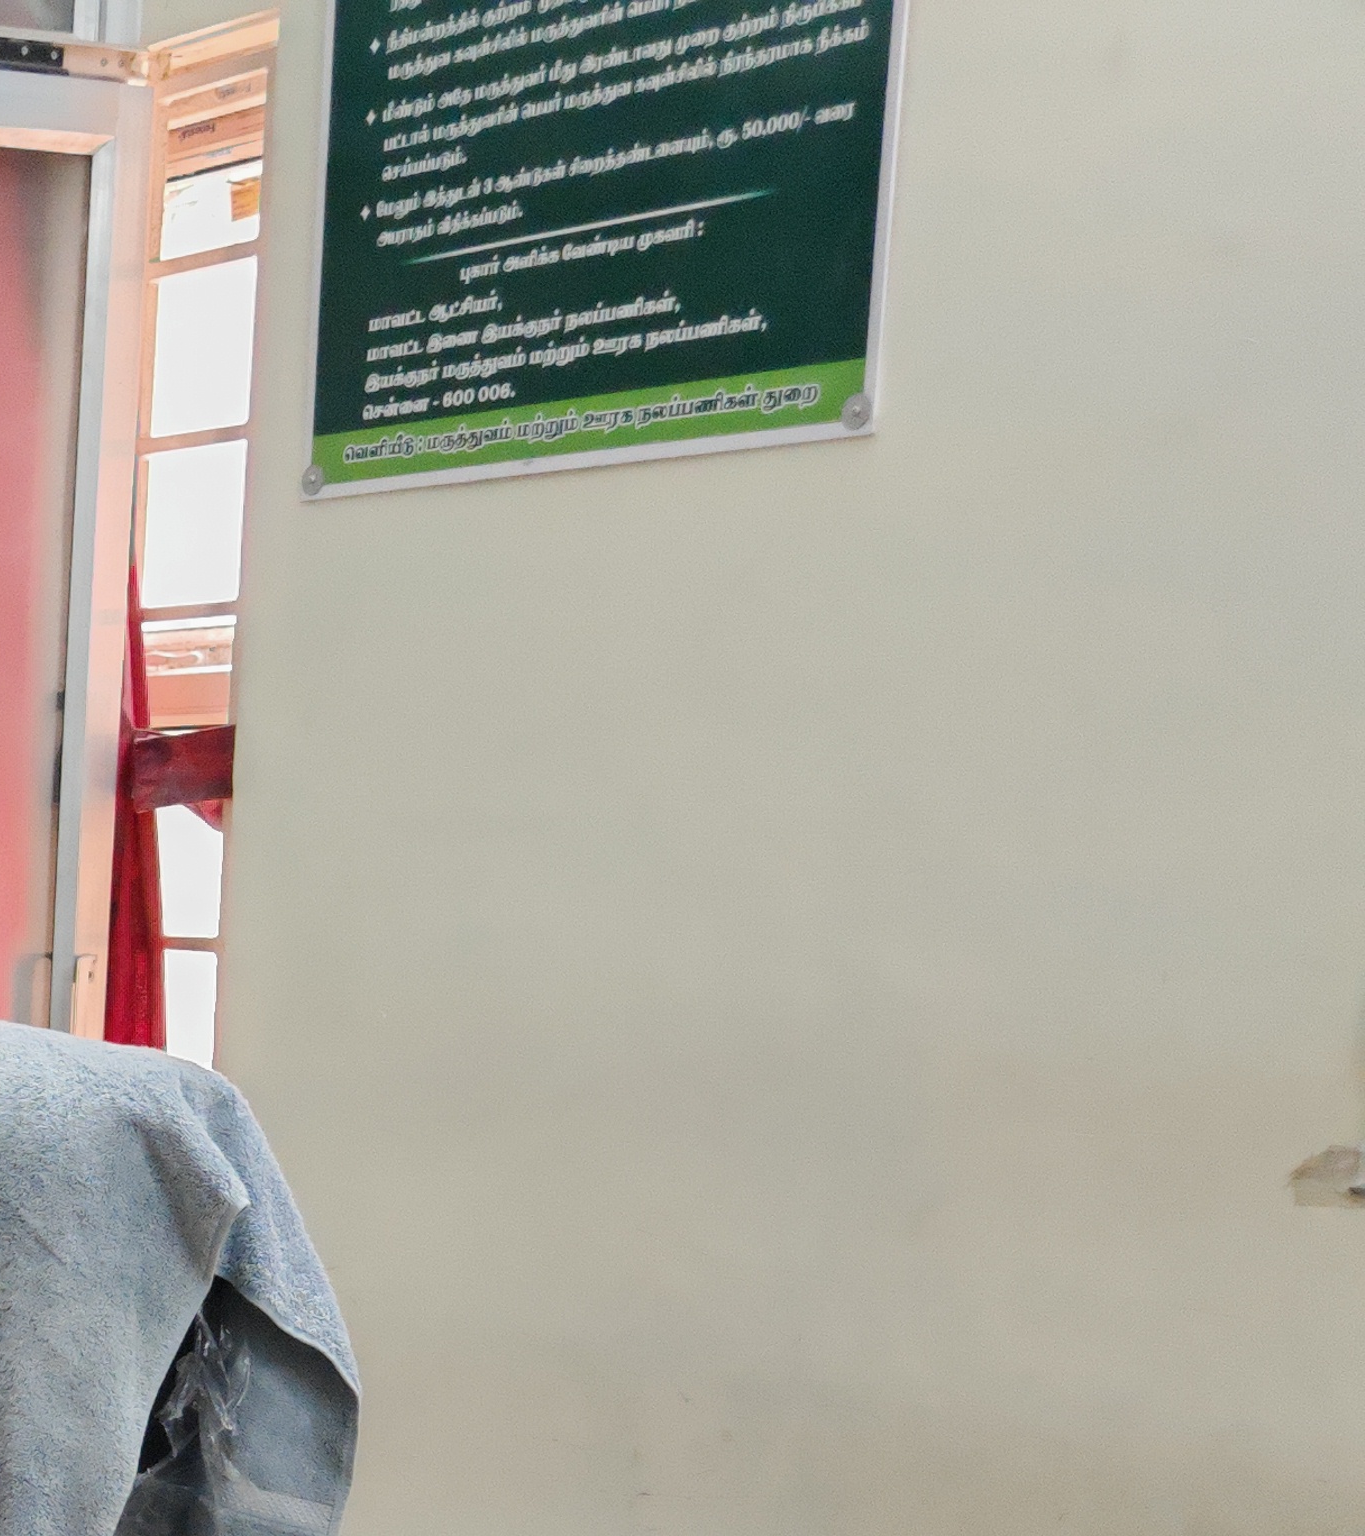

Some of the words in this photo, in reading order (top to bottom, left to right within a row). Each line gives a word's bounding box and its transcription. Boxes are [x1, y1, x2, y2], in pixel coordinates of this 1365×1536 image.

[442, 388, 474, 407] 600
[477, 382, 516, 402] 006.
[761, 384, 819, 415] துறை
